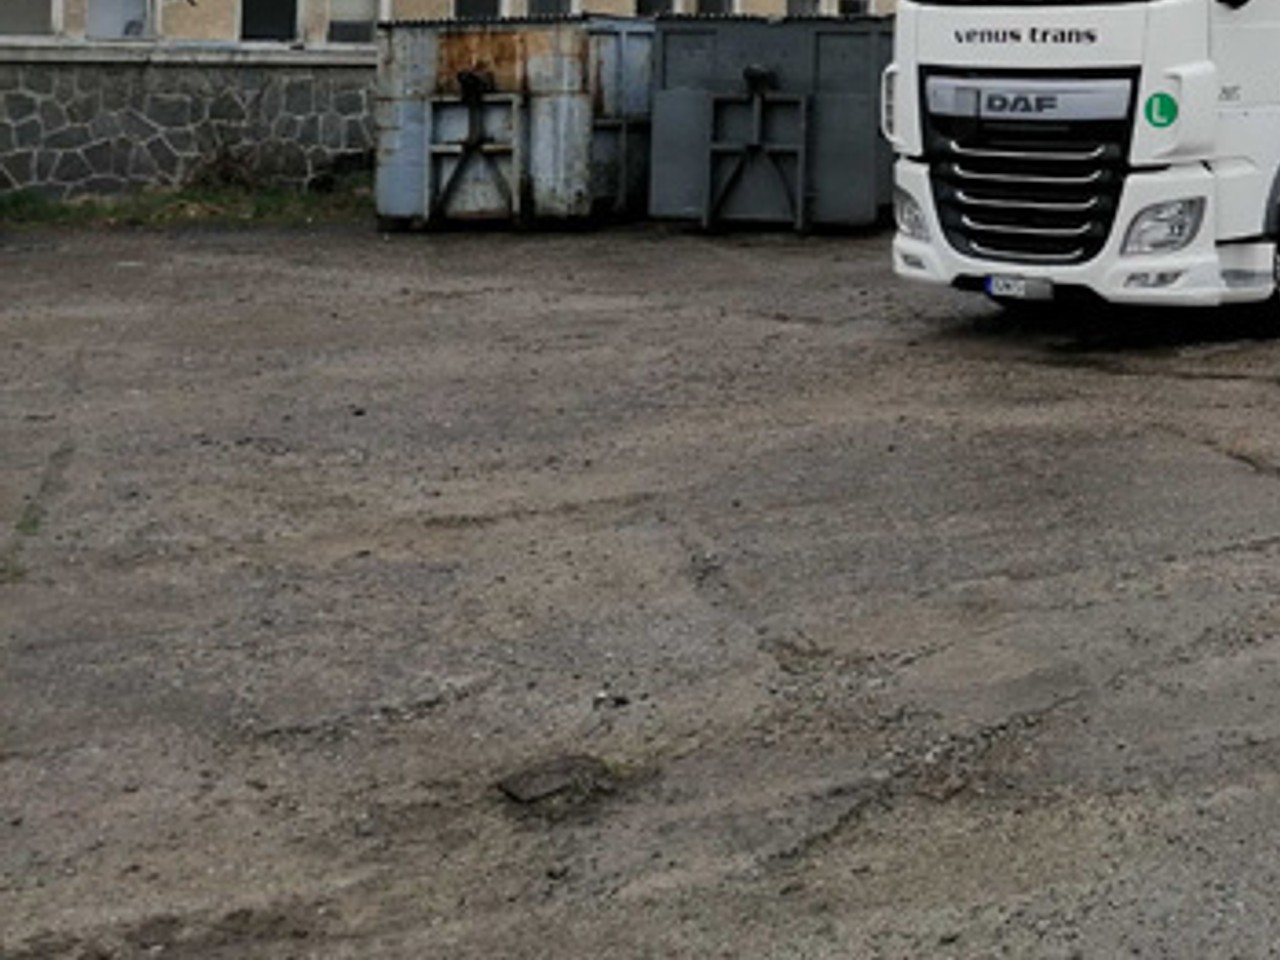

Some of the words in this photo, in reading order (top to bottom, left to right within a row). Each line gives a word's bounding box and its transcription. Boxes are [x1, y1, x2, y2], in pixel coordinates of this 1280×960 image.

[954, 29, 1022, 43] venus
[1029, 27, 1097, 43] trans
[987, 94, 1057, 113] DAF
[1151, 96, 1168, 124] L
